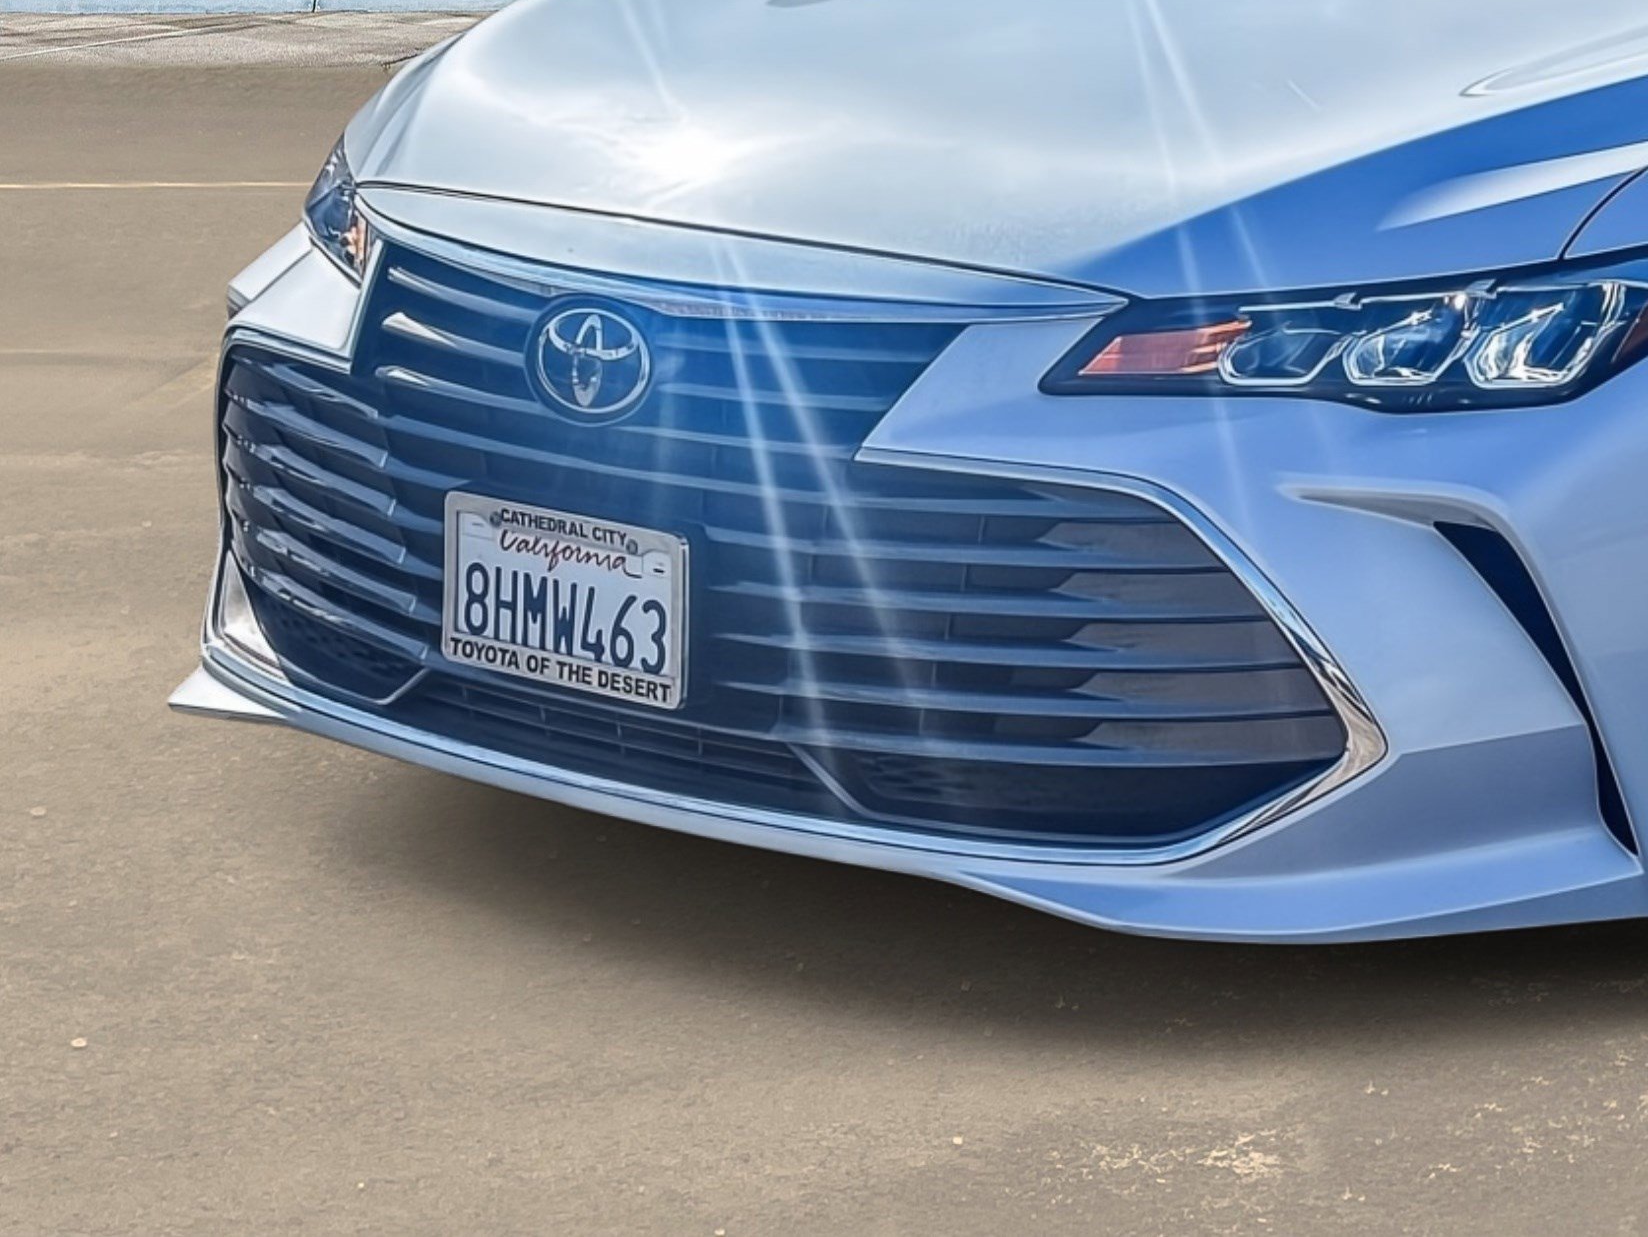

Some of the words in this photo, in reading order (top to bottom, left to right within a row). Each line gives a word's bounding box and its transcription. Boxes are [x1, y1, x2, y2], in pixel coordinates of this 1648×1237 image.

[500, 508, 585, 540] CATHEDRAL
[592, 525, 627, 547] CITY
[500, 529, 642, 579] California
[464, 562, 667, 676] 8HMW463
[450, 637, 520, 670] TOYOTA
[526, 654, 550, 676] OF
[556, 661, 593, 686] THE
[597, 670, 672, 703] DESERT
